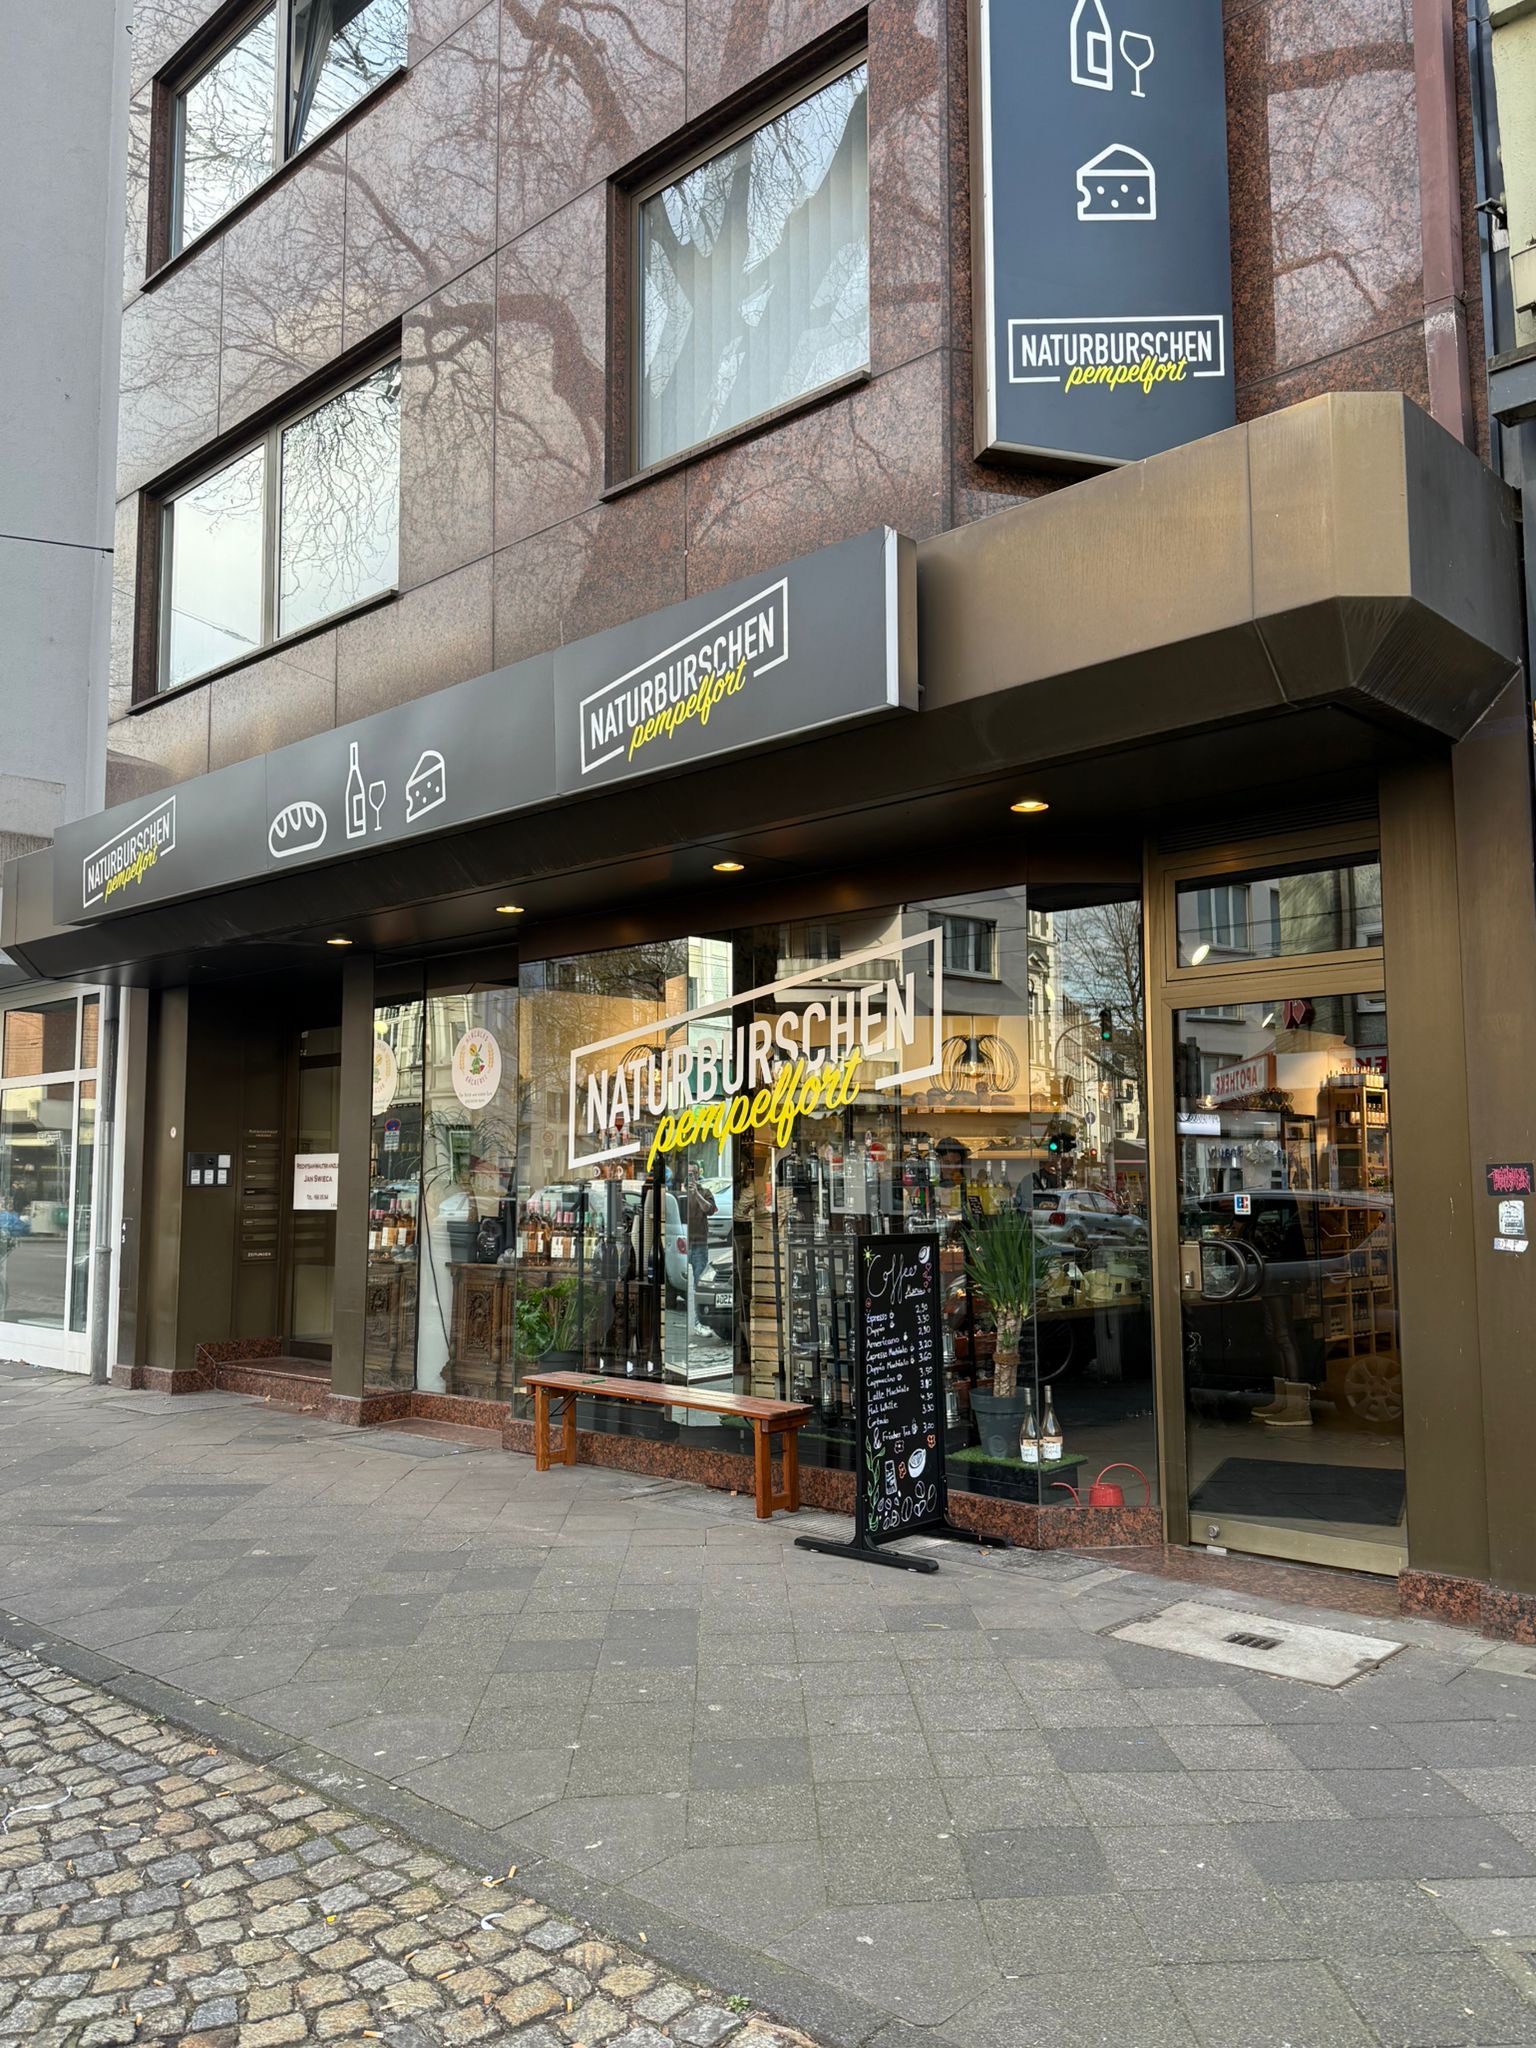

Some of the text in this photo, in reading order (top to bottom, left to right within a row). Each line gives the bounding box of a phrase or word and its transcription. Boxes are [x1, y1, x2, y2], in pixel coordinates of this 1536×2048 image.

[1021, 330, 1212, 367] NATURBURSCHEN
[1064, 354, 1187, 394] pempelfort
[591, 606, 775, 751] NATURBURSCHEN
[628, 655, 748, 763] pempelfort
[87, 812, 170, 893] NATURBURSCHEN
[104, 842, 158, 904] pempelfort
[587, 972, 915, 1134] NATURBURSCHEN
[645, 1045, 864, 1173] pempelfort
[867, 1253, 918, 1305] Coffee
[866, 1336, 900, 1349] Americano
[866, 1362, 886, 1375] Doppio
[867, 1390, 886, 1402] Latte
[867, 1403, 879, 1416] Flat
[880, 1400, 899, 1412] White
[867, 1414, 890, 1429] Cortado
